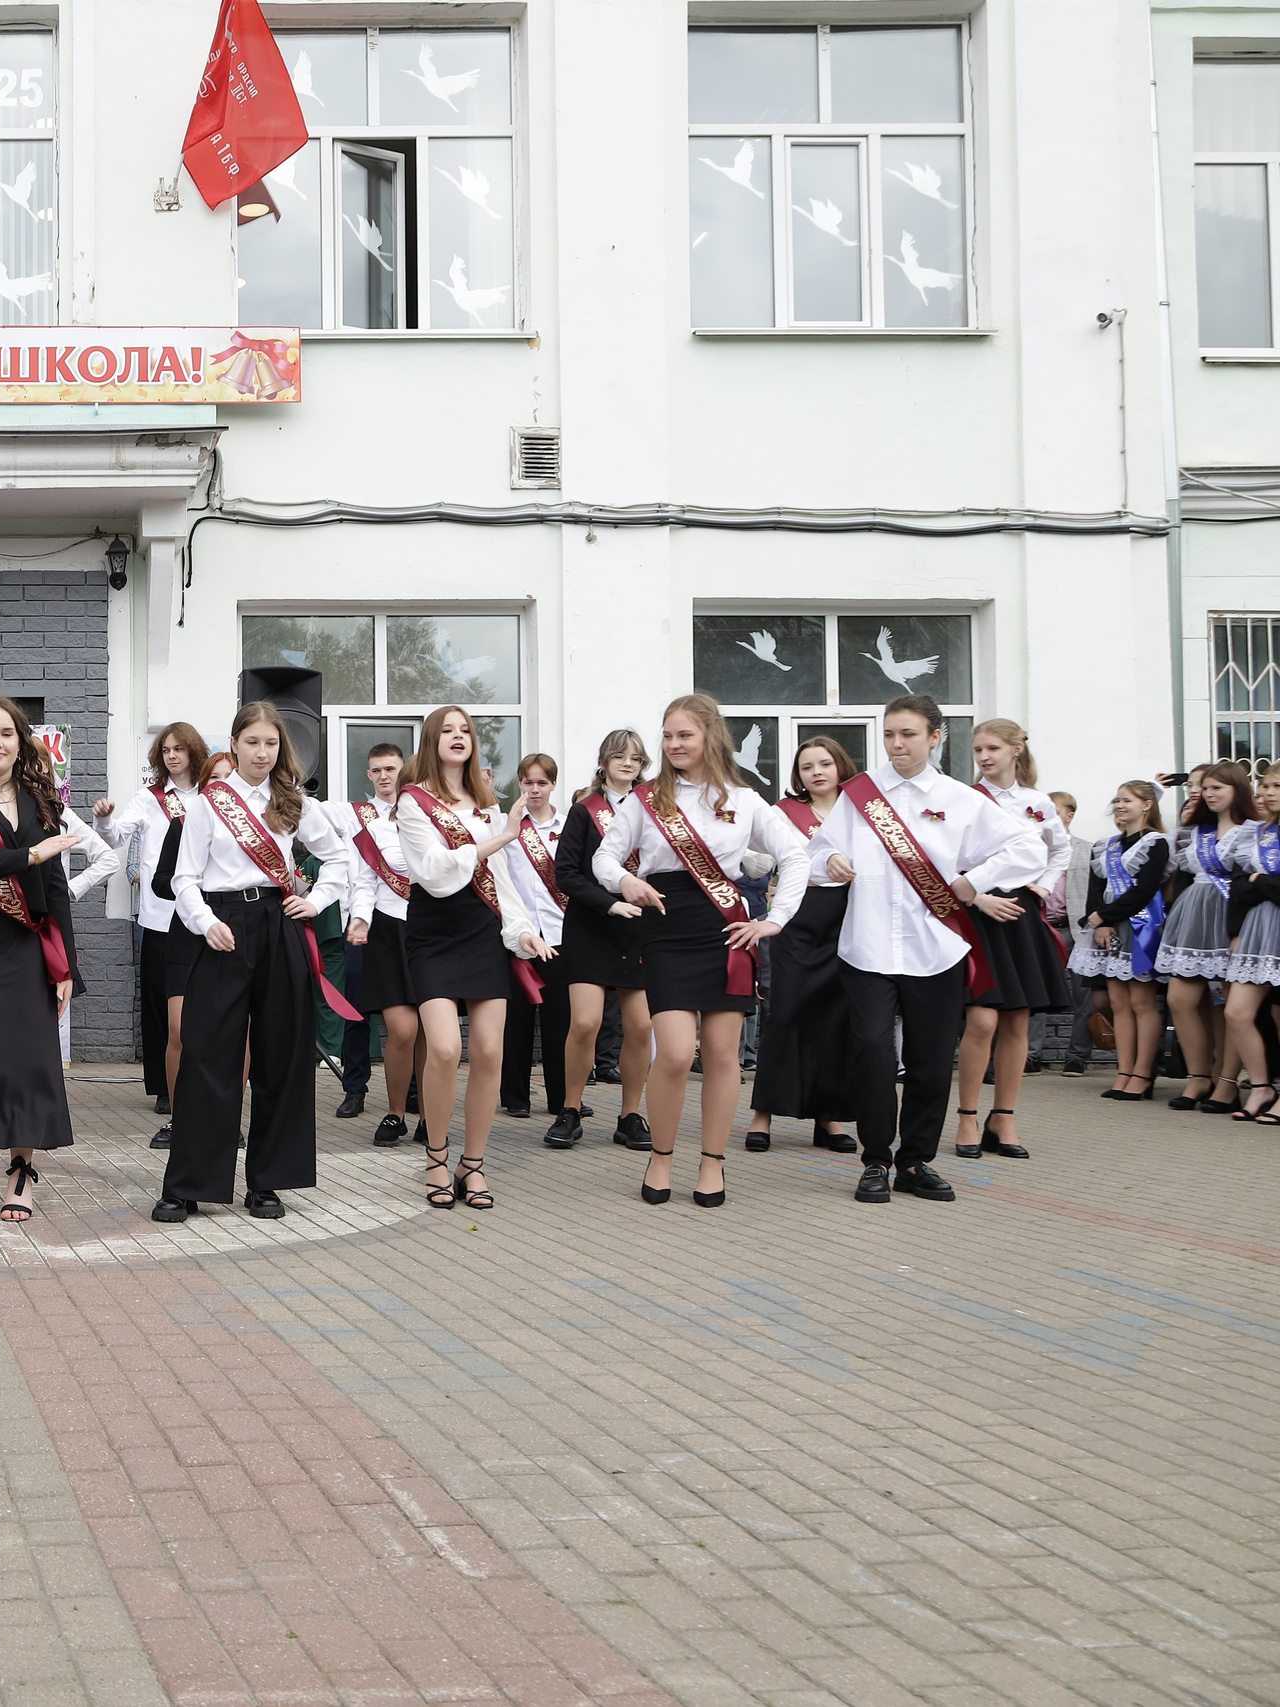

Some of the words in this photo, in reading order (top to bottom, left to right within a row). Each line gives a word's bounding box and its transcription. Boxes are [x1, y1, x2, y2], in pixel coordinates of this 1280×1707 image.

[236, 61, 259, 98] ОРДЕНА
[876, 820, 935, 890] Выпускник
[920, 883, 961, 918] 2025
[700, 870, 740, 909] 2025
